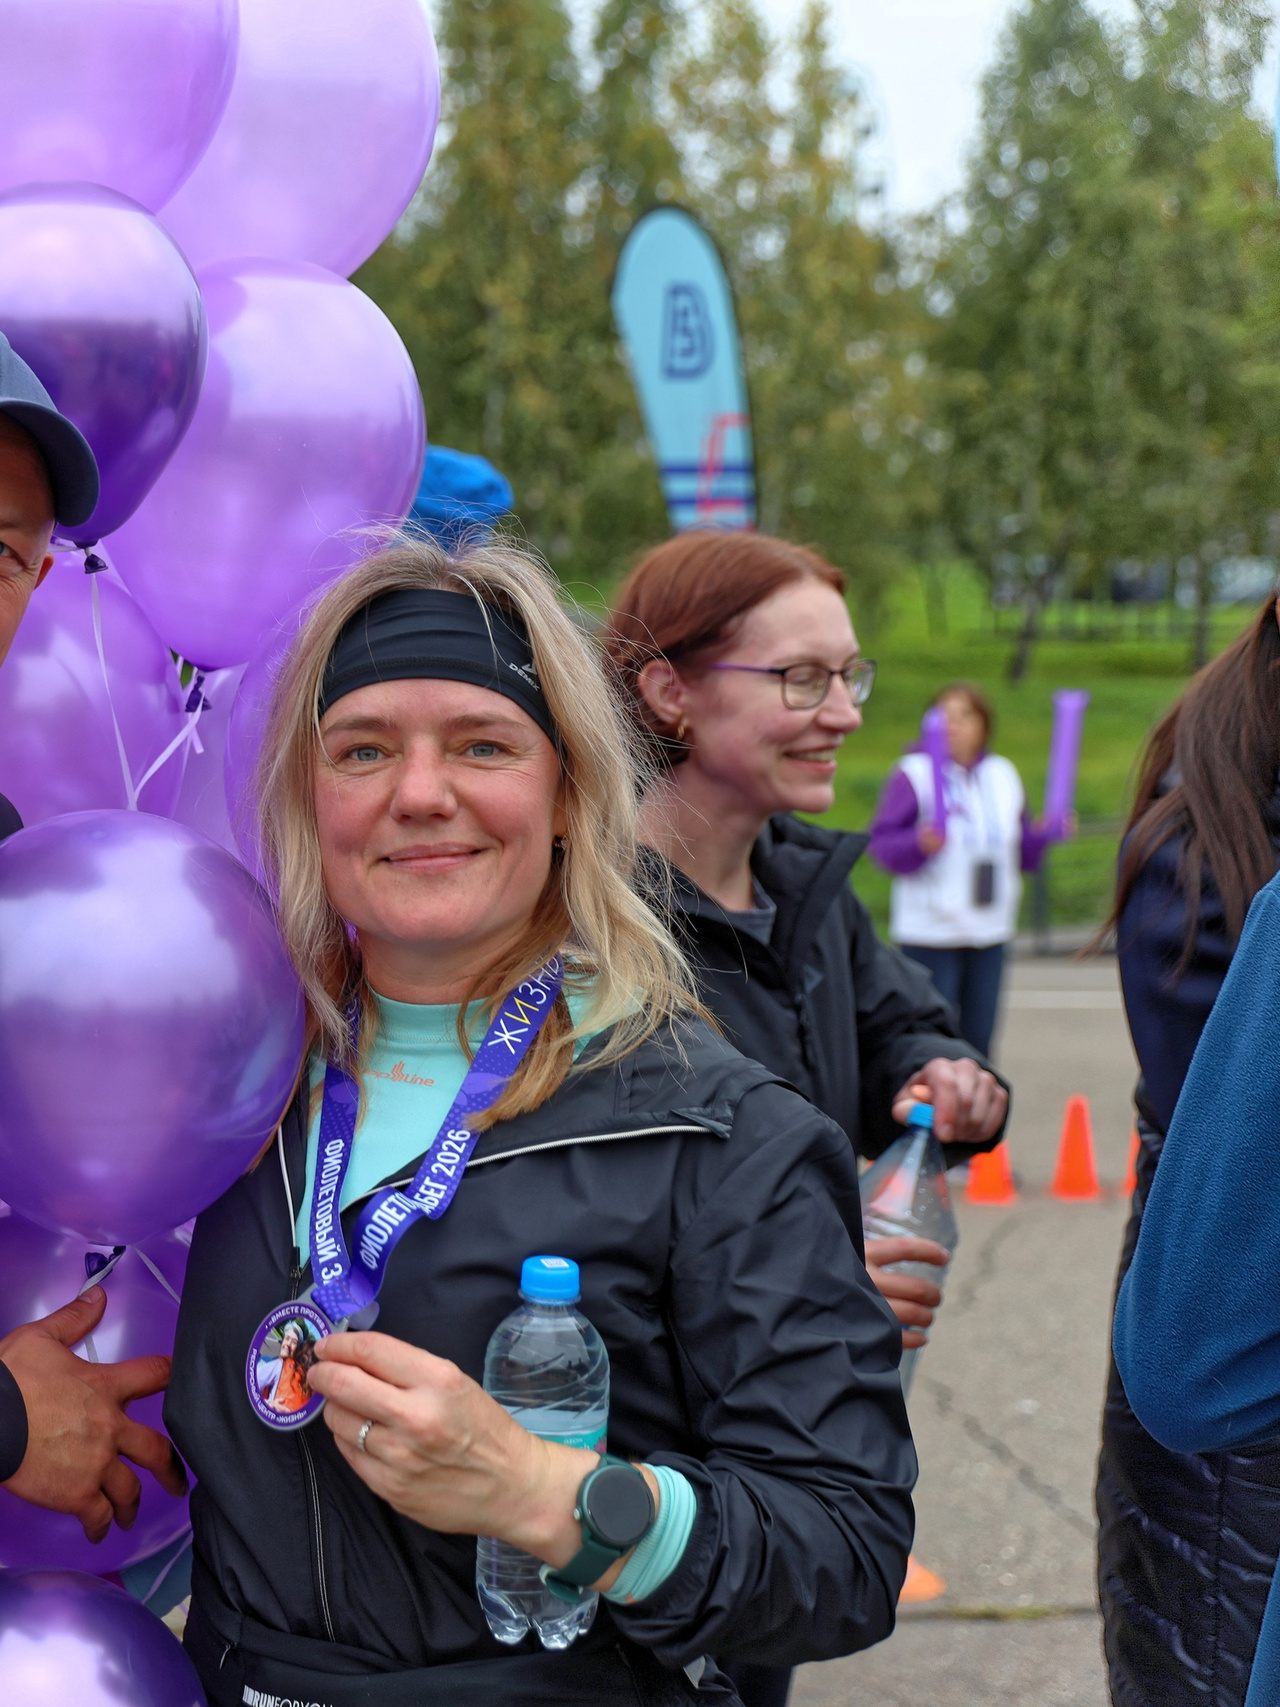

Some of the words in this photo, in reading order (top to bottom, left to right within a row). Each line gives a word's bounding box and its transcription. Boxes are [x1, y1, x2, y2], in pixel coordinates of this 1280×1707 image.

[508, 662, 540, 692] DEMIX
[314, 1138, 345, 1264] ФИОЛЕТОВЫЙ
[359, 1191, 419, 1270] ФИОЛЕТО
[412, 1176, 448, 1214] АБЕГ
[430, 1129, 471, 1178] 2026
